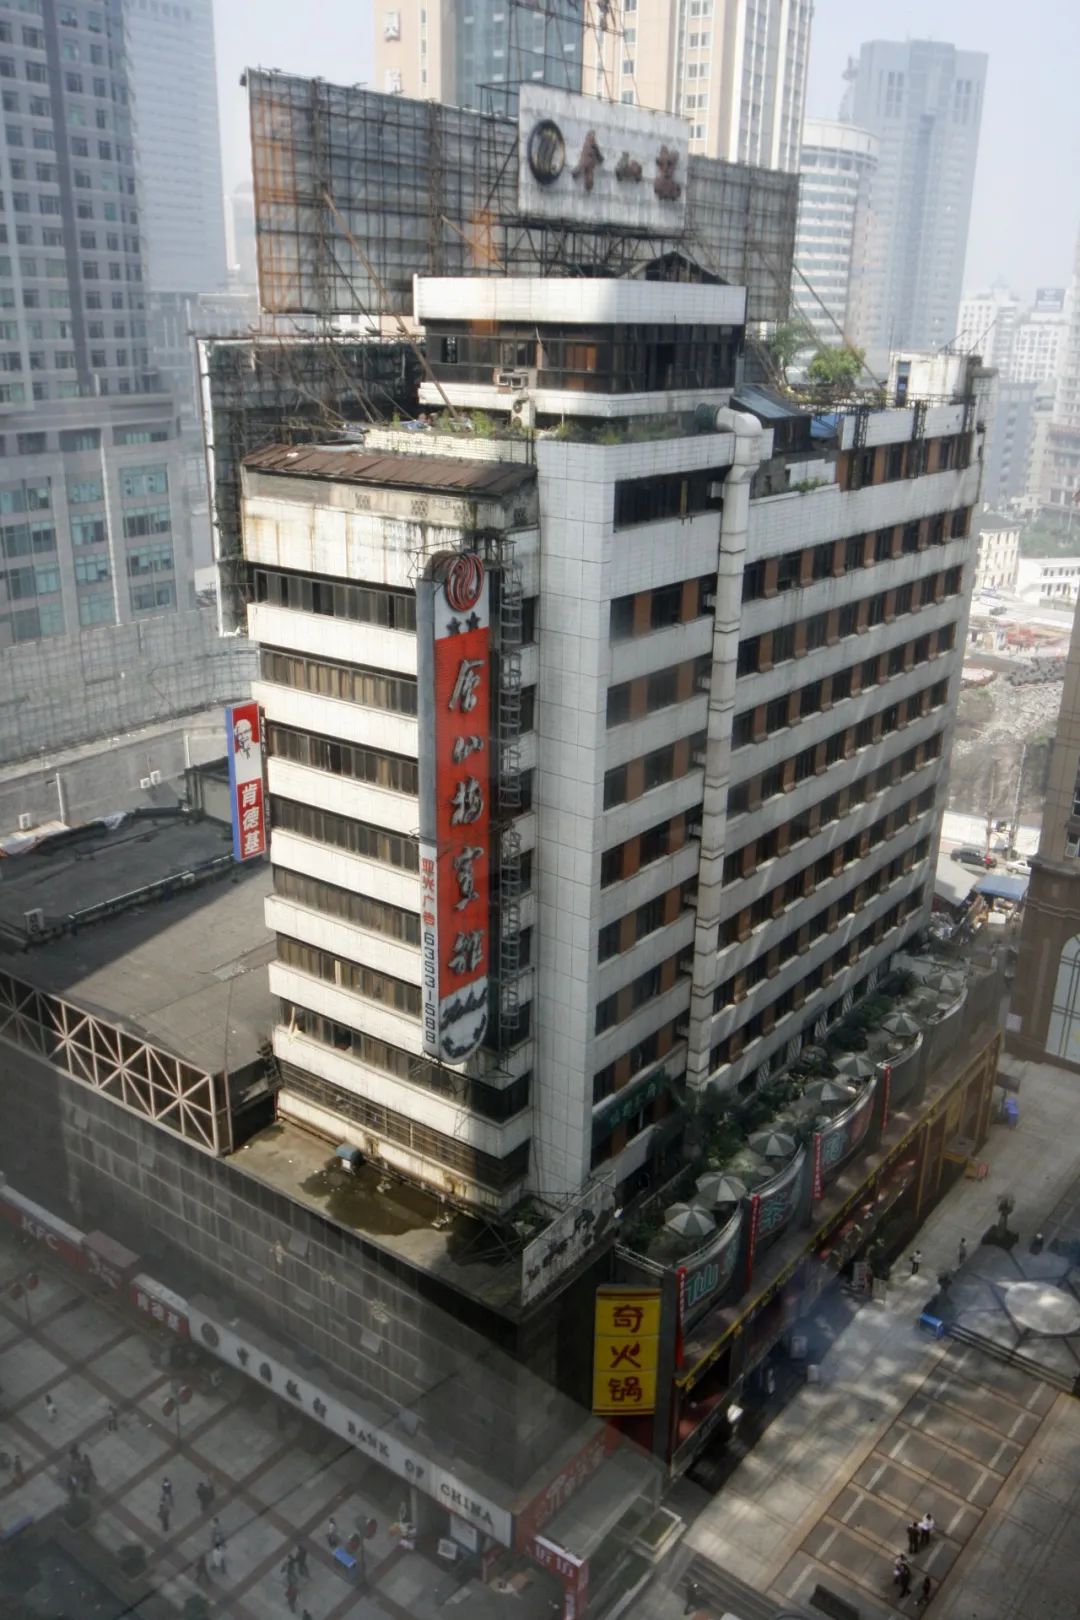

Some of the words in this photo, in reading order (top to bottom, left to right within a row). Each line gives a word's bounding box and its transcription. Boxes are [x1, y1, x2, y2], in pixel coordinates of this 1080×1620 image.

[242, 783, 260, 855] 肯德基
[347, 1421, 390, 1458] BANK
[404, 1459, 425, 1479] OF
[440, 1483, 493, 1527] CHINA
